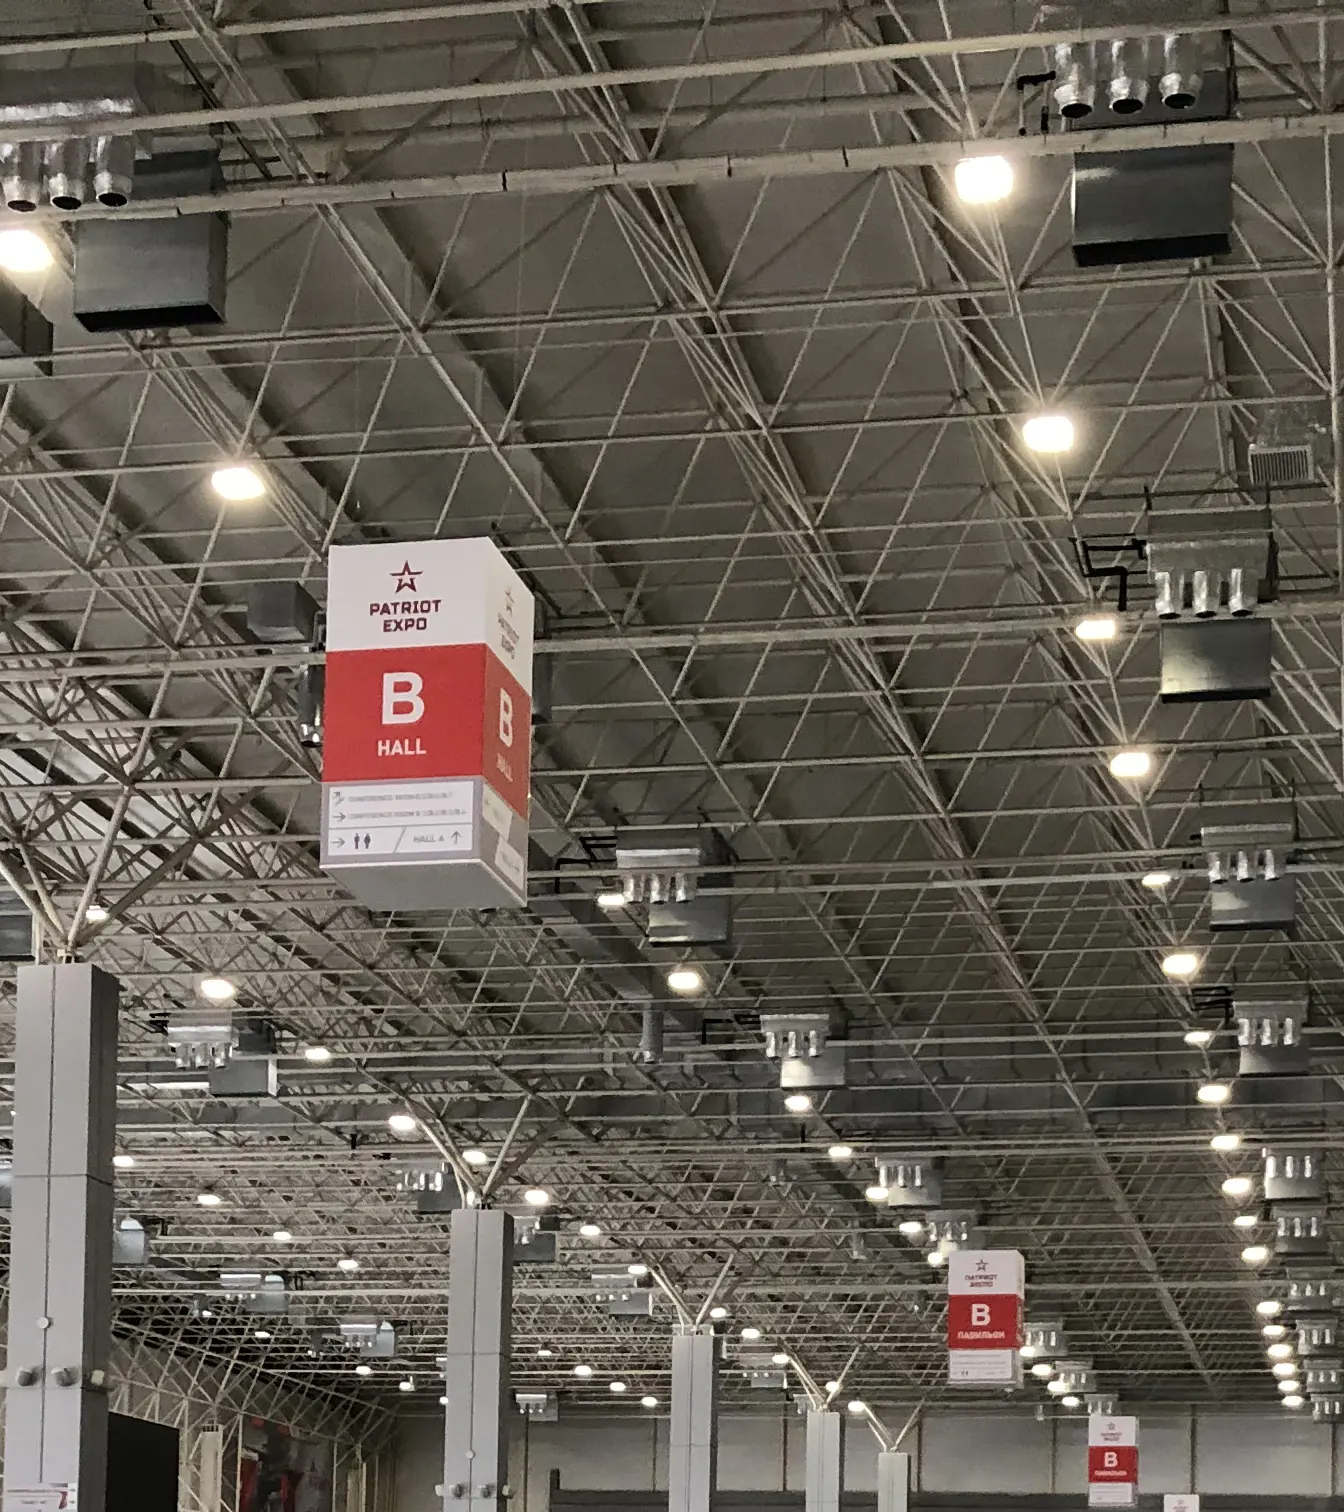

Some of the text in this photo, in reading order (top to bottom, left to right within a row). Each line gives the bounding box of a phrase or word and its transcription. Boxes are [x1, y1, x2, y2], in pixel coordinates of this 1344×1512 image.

[369, 599, 442, 617] PATRIOT
[382, 617, 428, 633] EXPO
[381, 671, 425, 725] B
[499, 687, 513, 748] B
[377, 739, 427, 757] HALL
[971, 1303, 991, 1327] В
